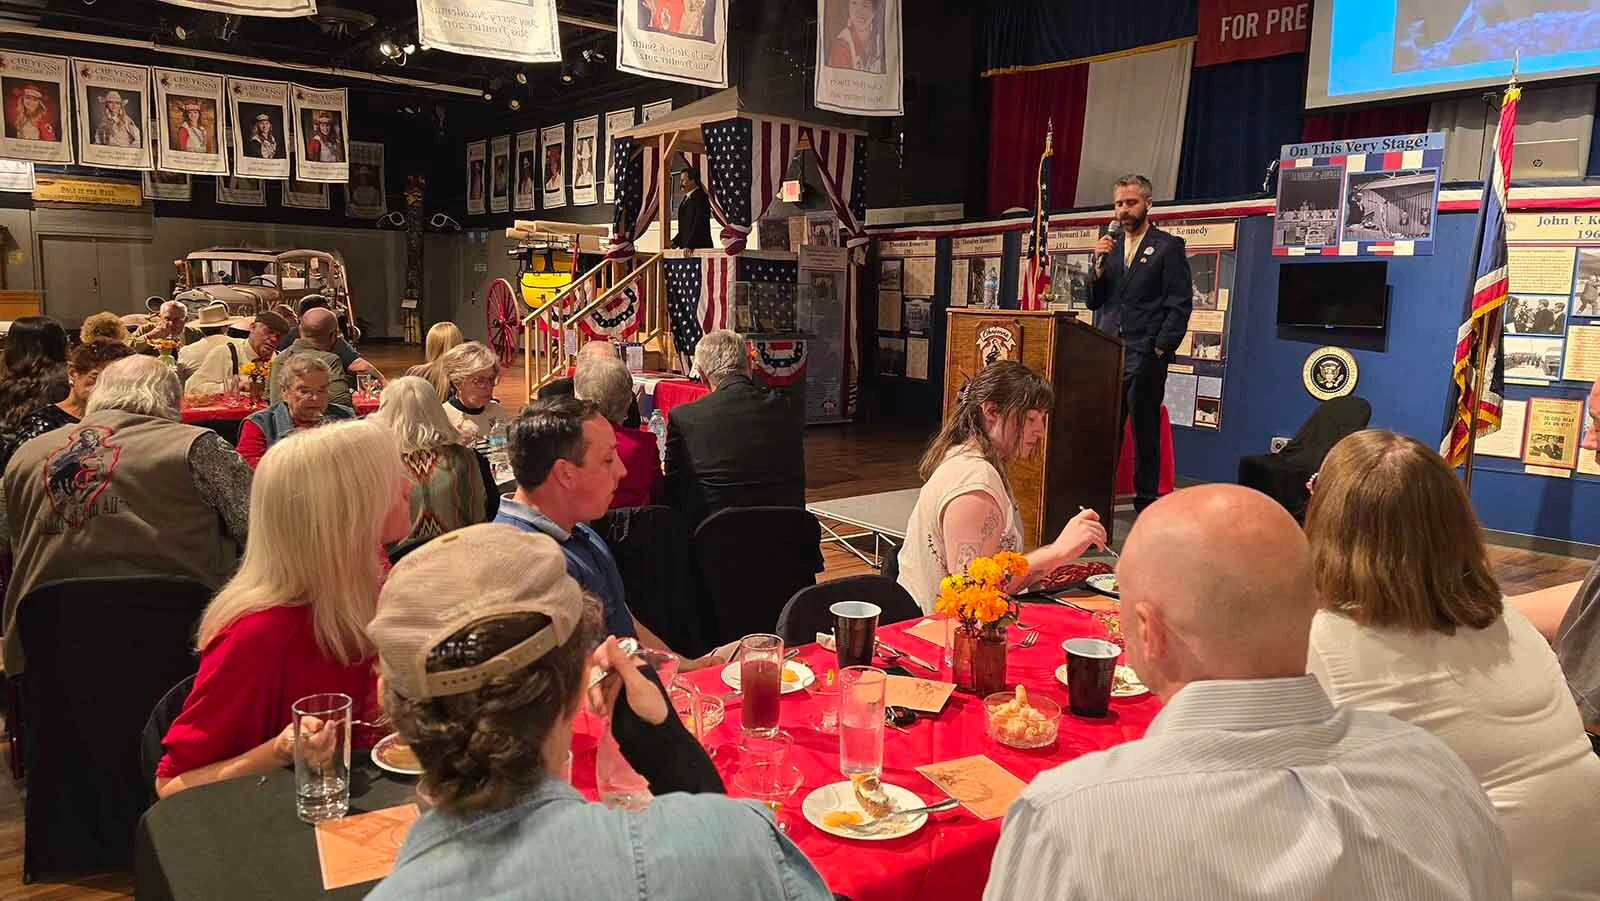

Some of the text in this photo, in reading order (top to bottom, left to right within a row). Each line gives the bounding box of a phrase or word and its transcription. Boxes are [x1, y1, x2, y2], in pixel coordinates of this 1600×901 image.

[1220, 3, 1308, 42] FOR PRE
[10, 57, 63, 72] CHEYENNE
[94, 66, 144, 81] CHEYENNE
[173, 75, 217, 89] CHEYENNE
[244, 83, 284, 96] CHEYENNE
[1289, 135, 1429, 157] On This Very Stage!
[1536, 215, 1569, 228] John
[1574, 215, 1584, 225] F.
[1057, 231, 1079, 239] Howard
[1176, 226, 1208, 236] Kennedy
